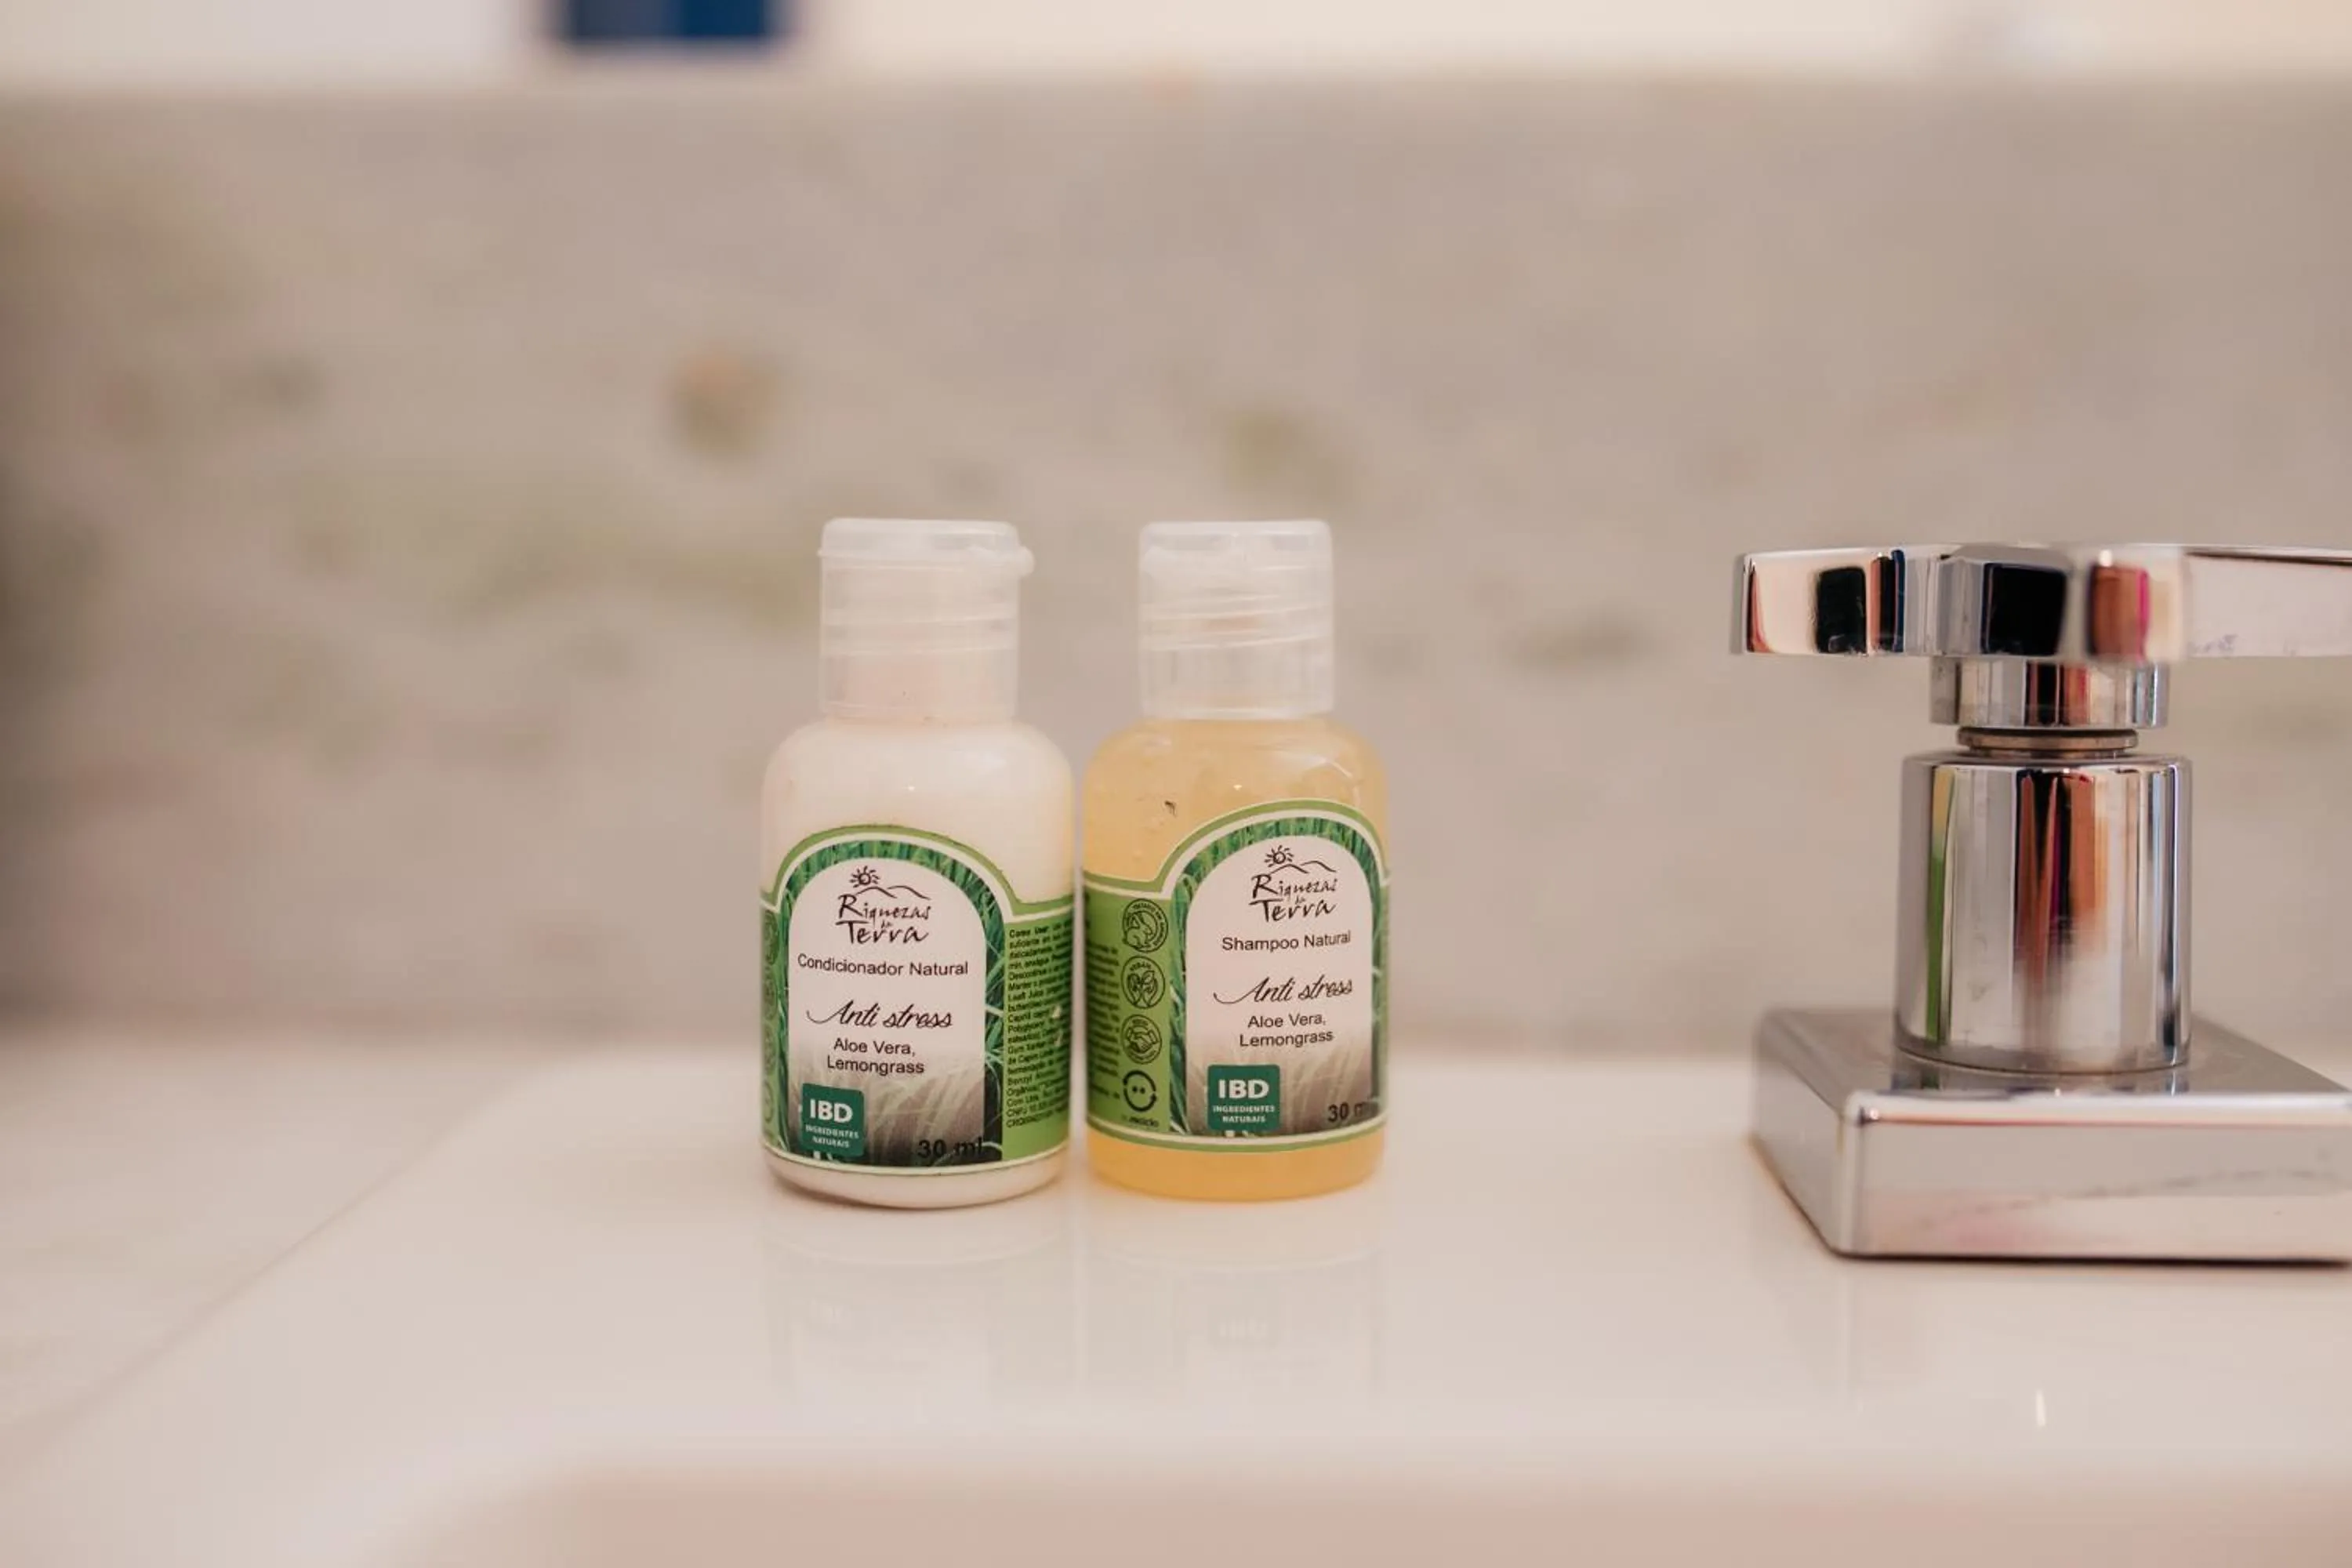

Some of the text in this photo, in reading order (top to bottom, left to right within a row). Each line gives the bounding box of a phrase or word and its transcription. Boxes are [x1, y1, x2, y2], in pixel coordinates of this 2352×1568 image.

[1251, 873, 1338, 902] Riquezas
[837, 894, 931, 927] Riquezas
[1248, 898, 1337, 923] Terra
[835, 920, 930, 944] Terra
[1221, 929, 1351, 953] Shampoo Natural
[797, 953, 969, 976] Condicionador Natural
[1213, 974, 1353, 1004] Anti stress
[806, 1000, 953, 1029] Anti stress
[1247, 1013, 1327, 1029] Aloe Vera,
[833, 1036, 916, 1057] Aloe Vera,
[1239, 1031, 1334, 1051] Lemongrass
[826, 1055, 925, 1076] Lemongrass
[1218, 1079, 1269, 1099] IBD
[810, 1098, 854, 1123] IBD
[1328, 1102, 1349, 1122] 30
[916, 1136, 982, 1159] 30 ml
